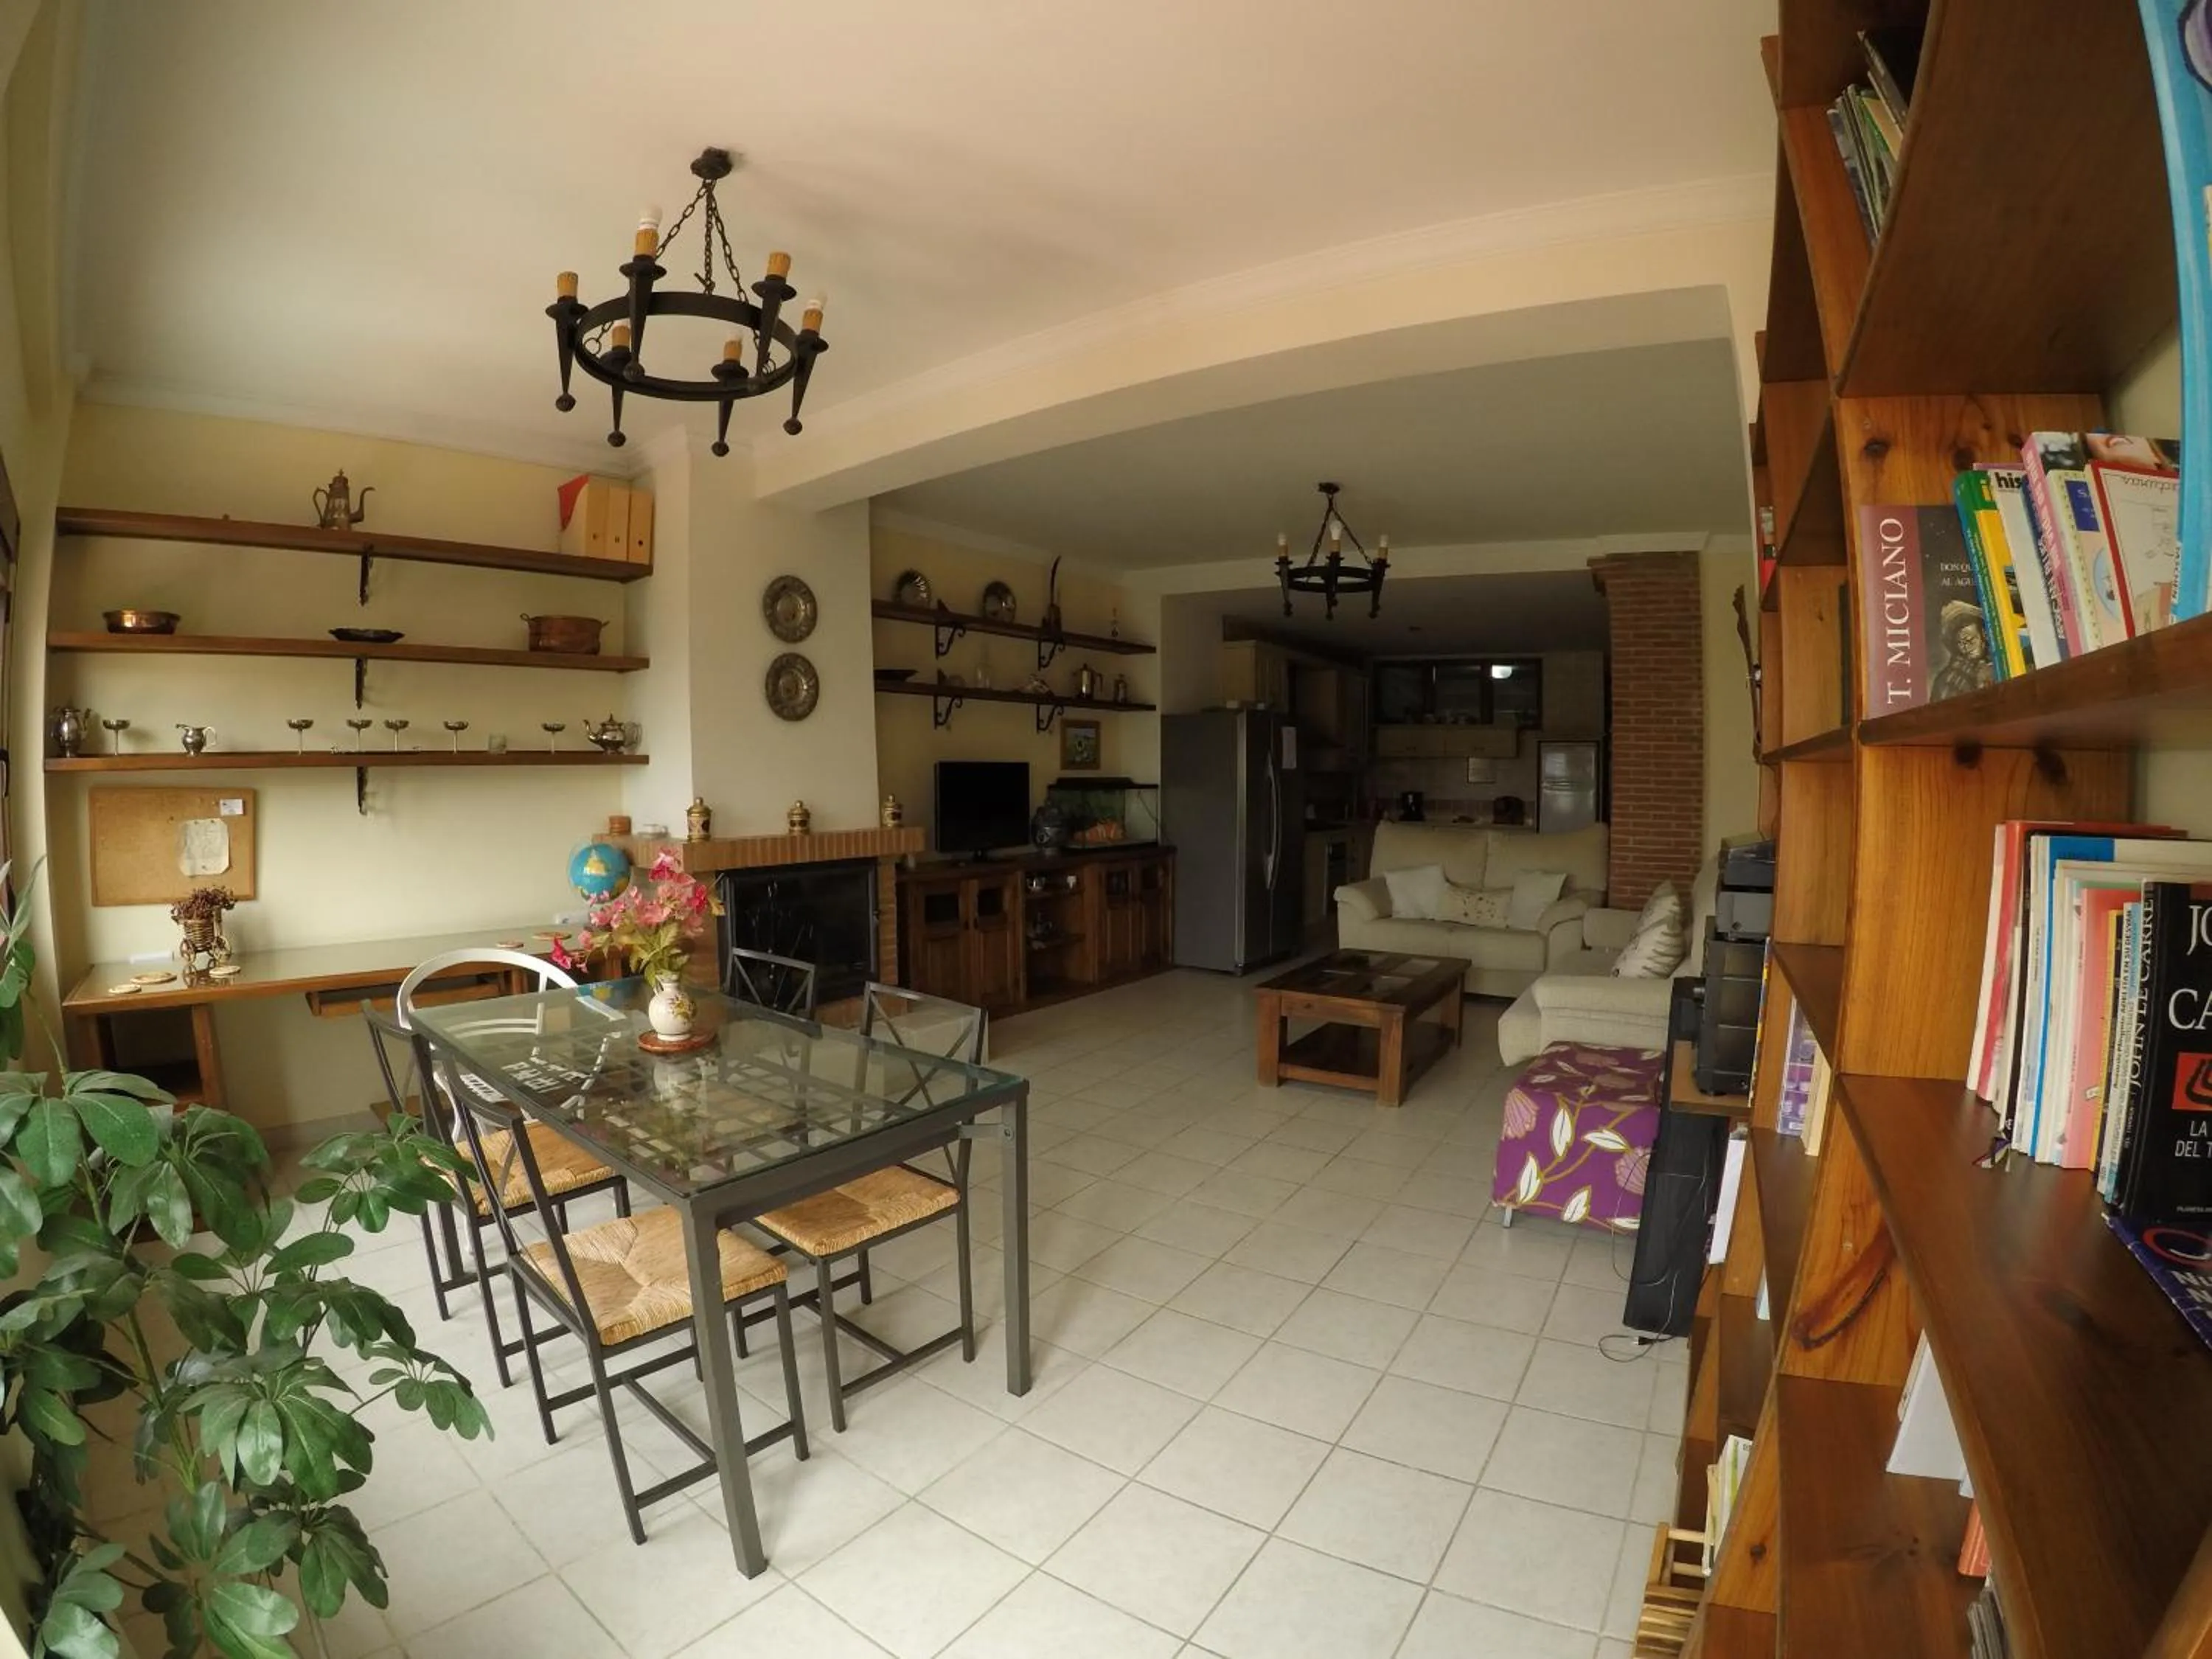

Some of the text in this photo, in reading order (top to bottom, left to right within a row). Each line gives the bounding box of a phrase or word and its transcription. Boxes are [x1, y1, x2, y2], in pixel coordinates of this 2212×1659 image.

[1879, 518, 1913, 704] T. MICIANO
[2189, 1120, 2208, 1137] LA
[2174, 1140, 2201, 1158] DEL
